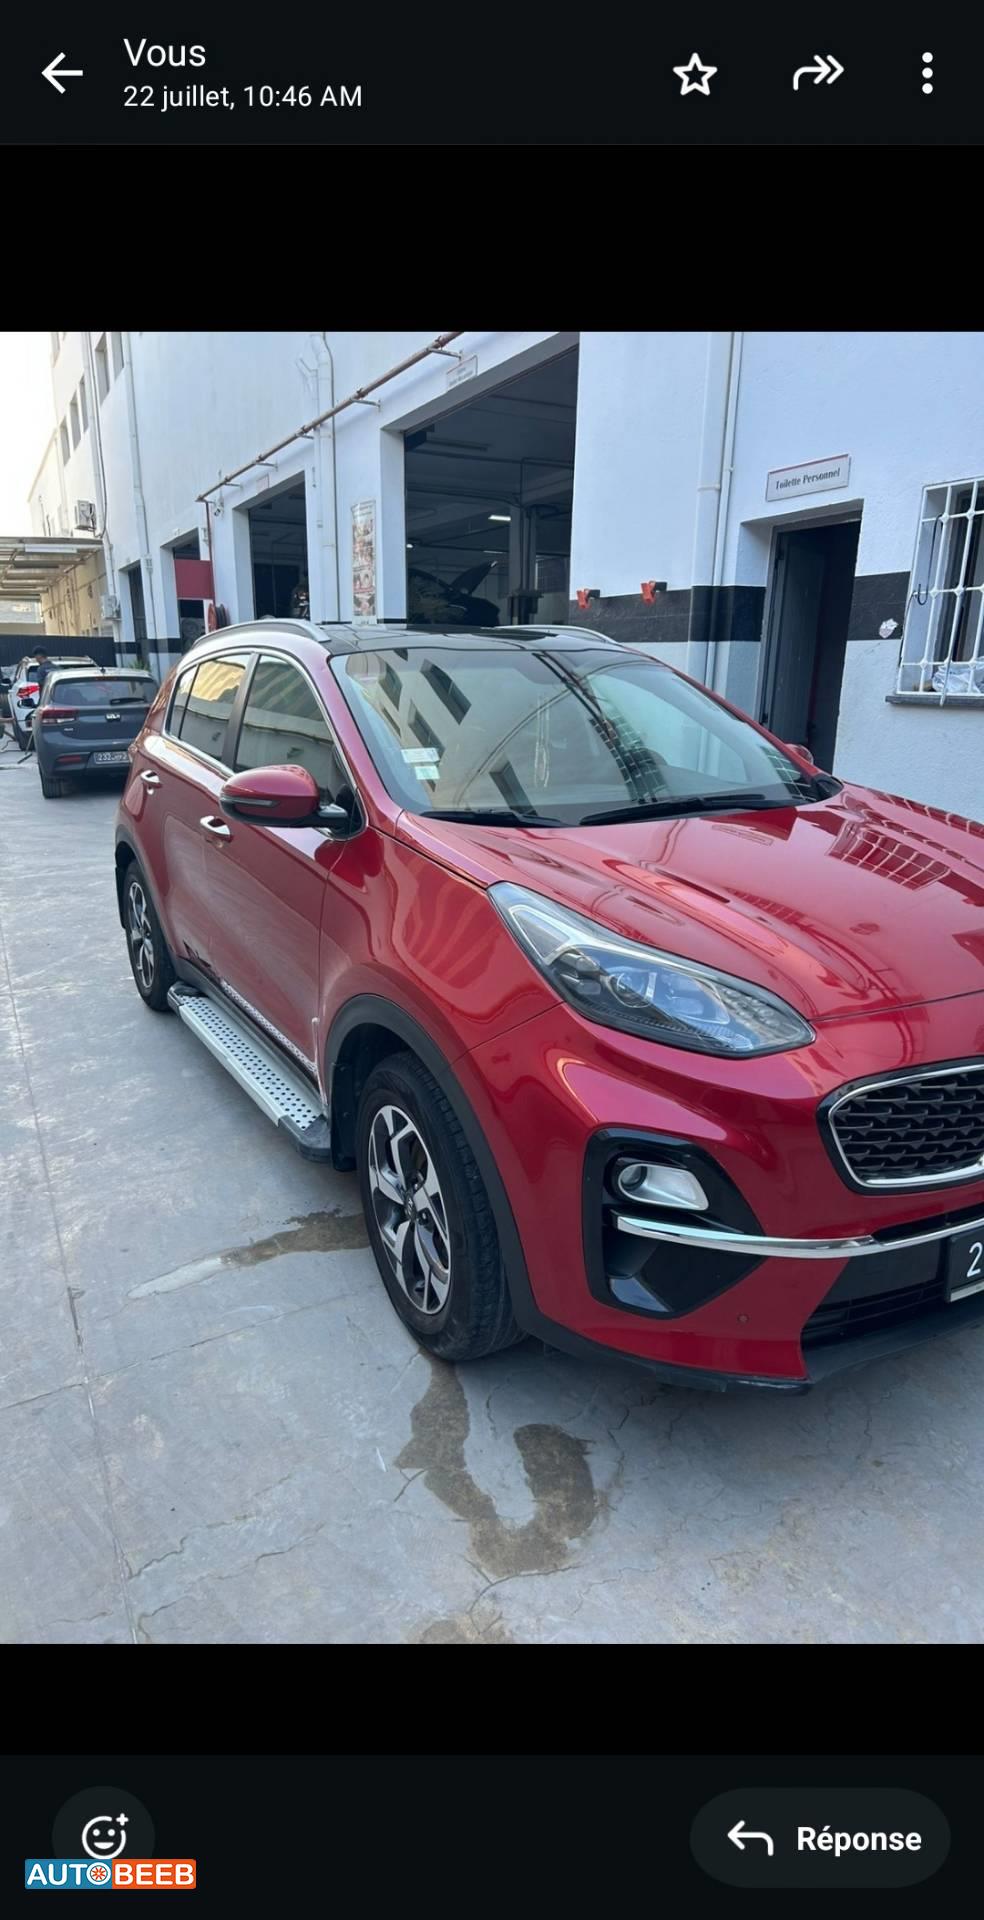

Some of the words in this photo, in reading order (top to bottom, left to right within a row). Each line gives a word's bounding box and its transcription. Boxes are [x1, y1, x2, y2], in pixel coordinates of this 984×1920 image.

[776, 476, 801, 490] Toilette
[803, 468, 841, 484] Personnel
[966, 1241, 983, 1278] 2
